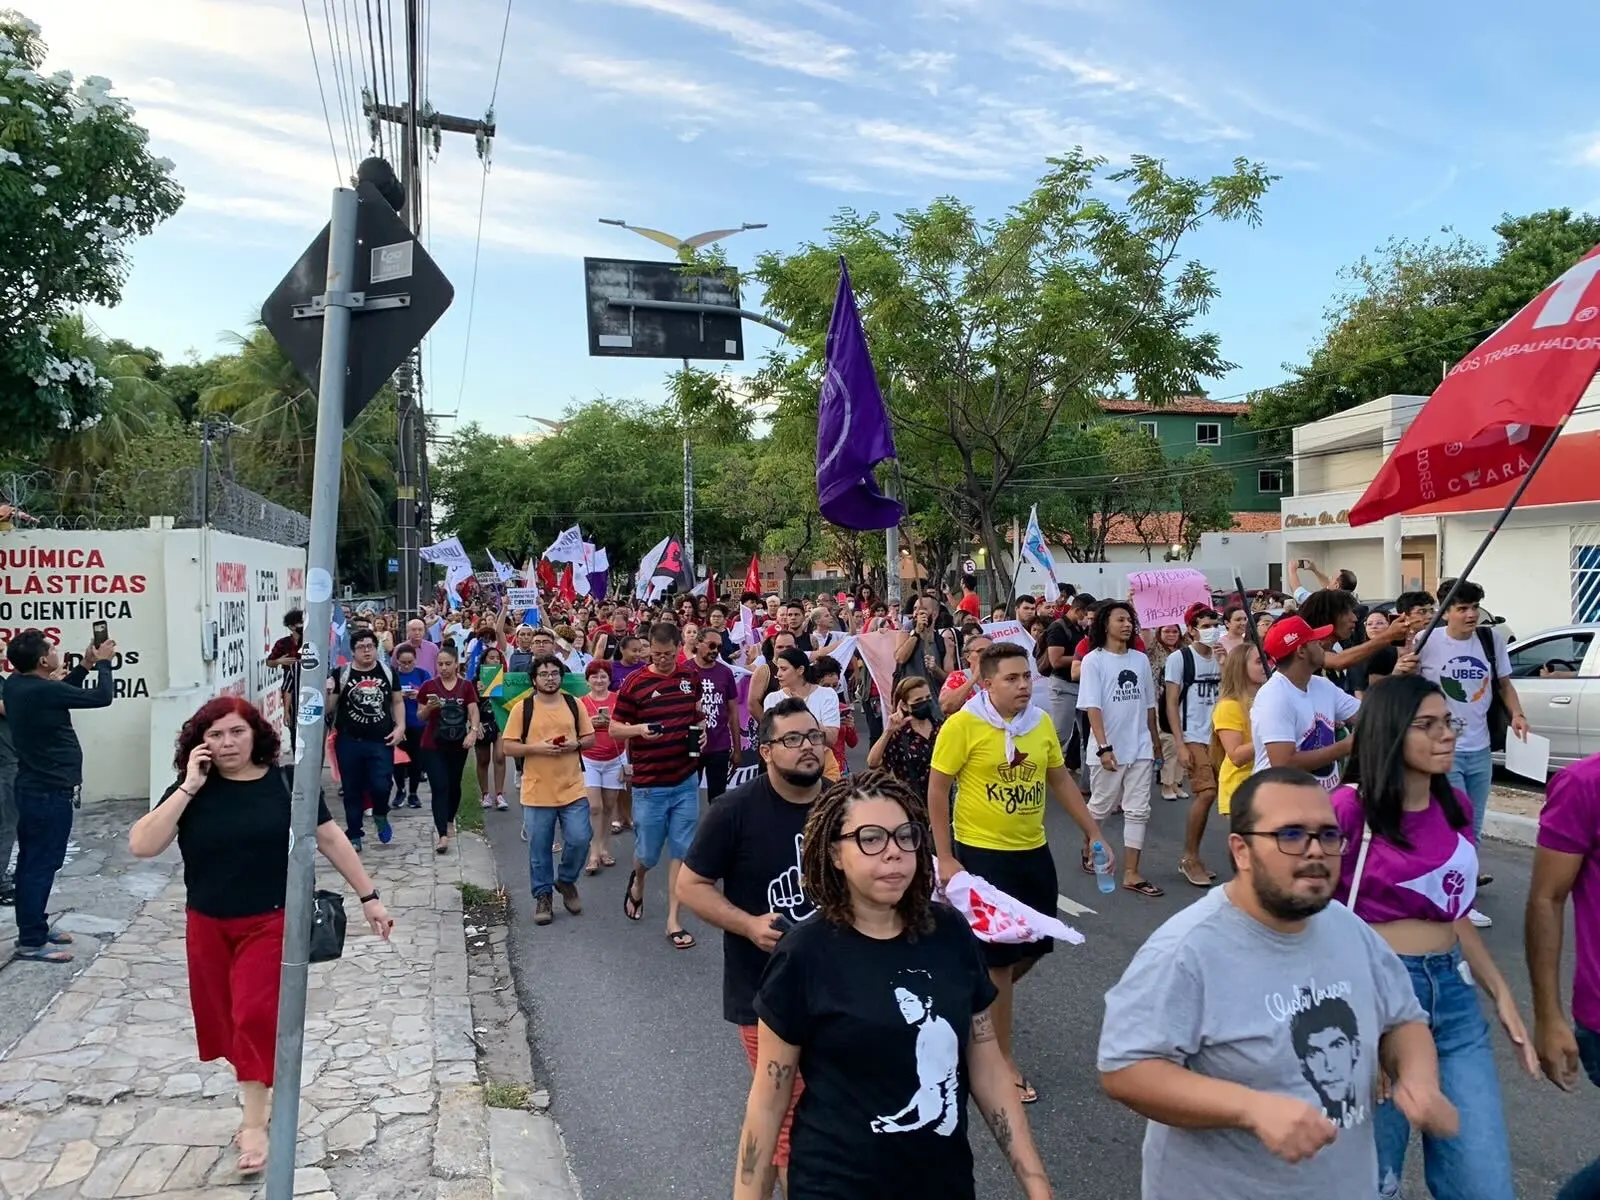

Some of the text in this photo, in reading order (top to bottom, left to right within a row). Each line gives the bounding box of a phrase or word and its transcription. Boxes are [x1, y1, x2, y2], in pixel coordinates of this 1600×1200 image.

[0, 570, 147, 594] LÁSTICAS
[21, 598, 132, 620] CIENTÍFICA
[219, 600, 246, 637] LIVROS
[1452, 668, 1484, 680] UBES
